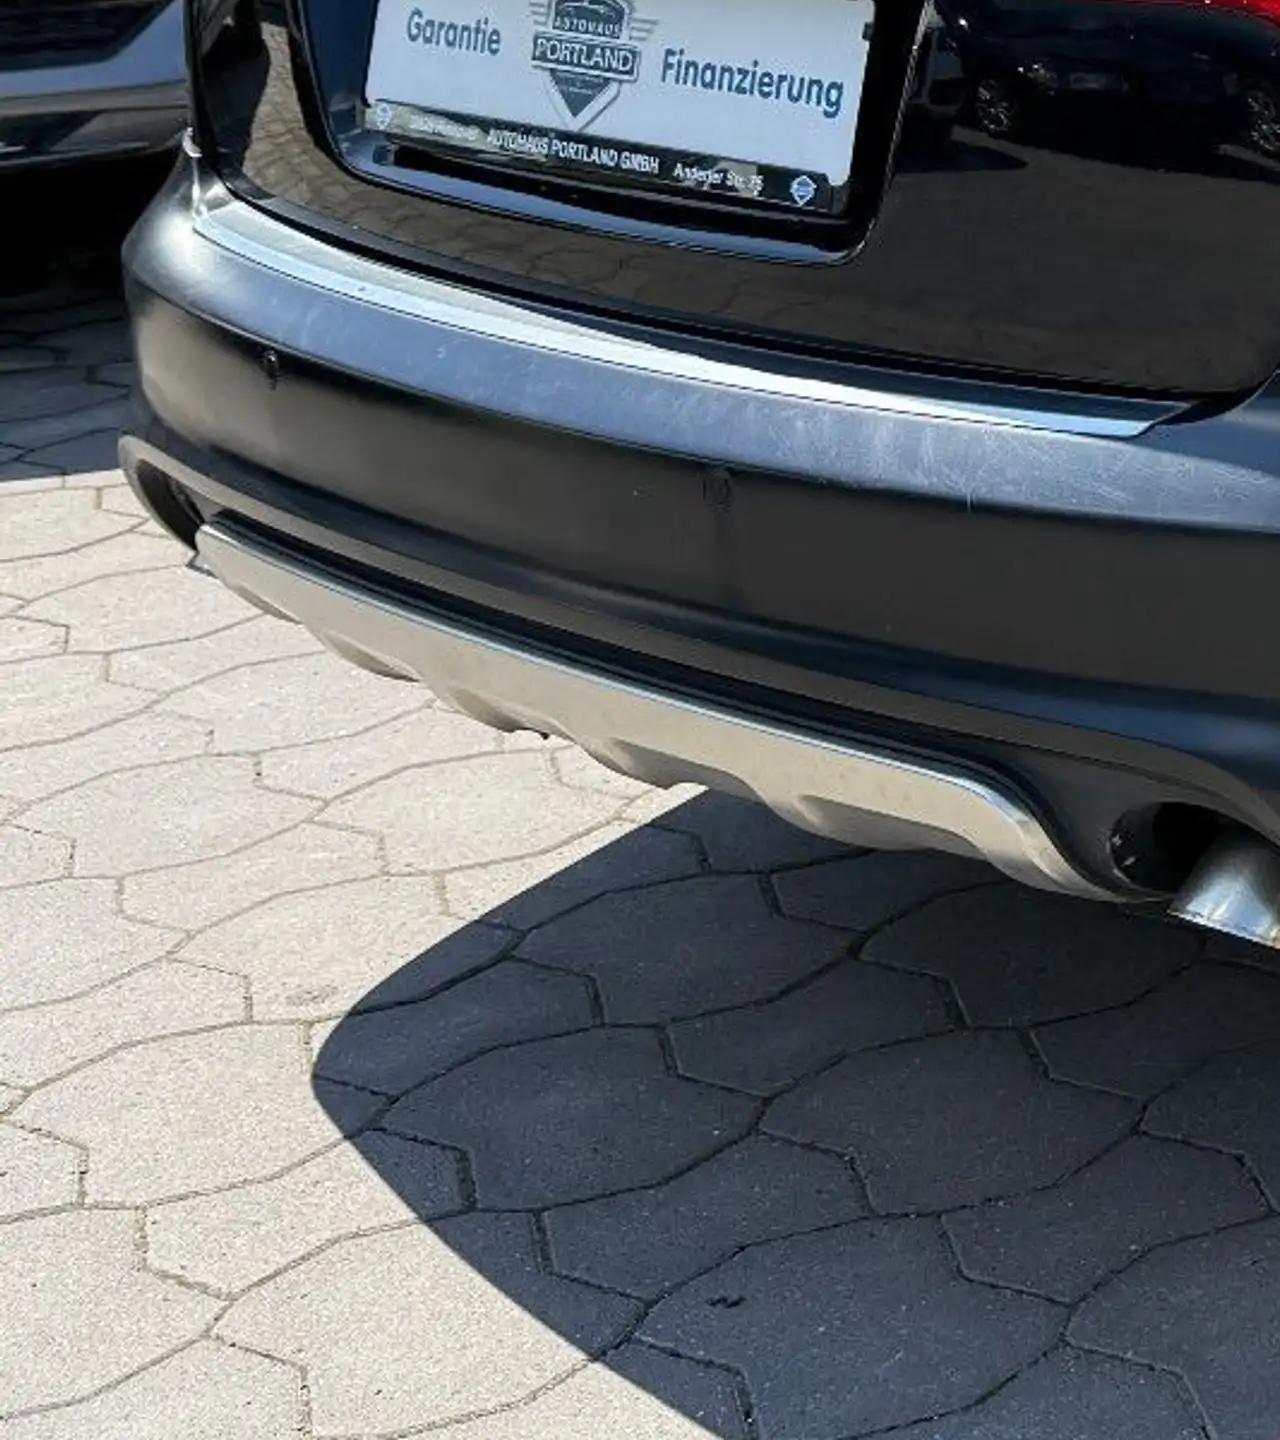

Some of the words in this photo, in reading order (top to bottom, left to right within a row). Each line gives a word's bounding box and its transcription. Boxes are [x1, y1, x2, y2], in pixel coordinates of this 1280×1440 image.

[407, 7, 501, 56] Garantie
[535, 37, 633, 72] PORTLAND
[660, 48, 844, 120] Finanzierung
[487, 126, 549, 155] AUTOHAUS
[551, 137, 617, 168] PORTLAND
